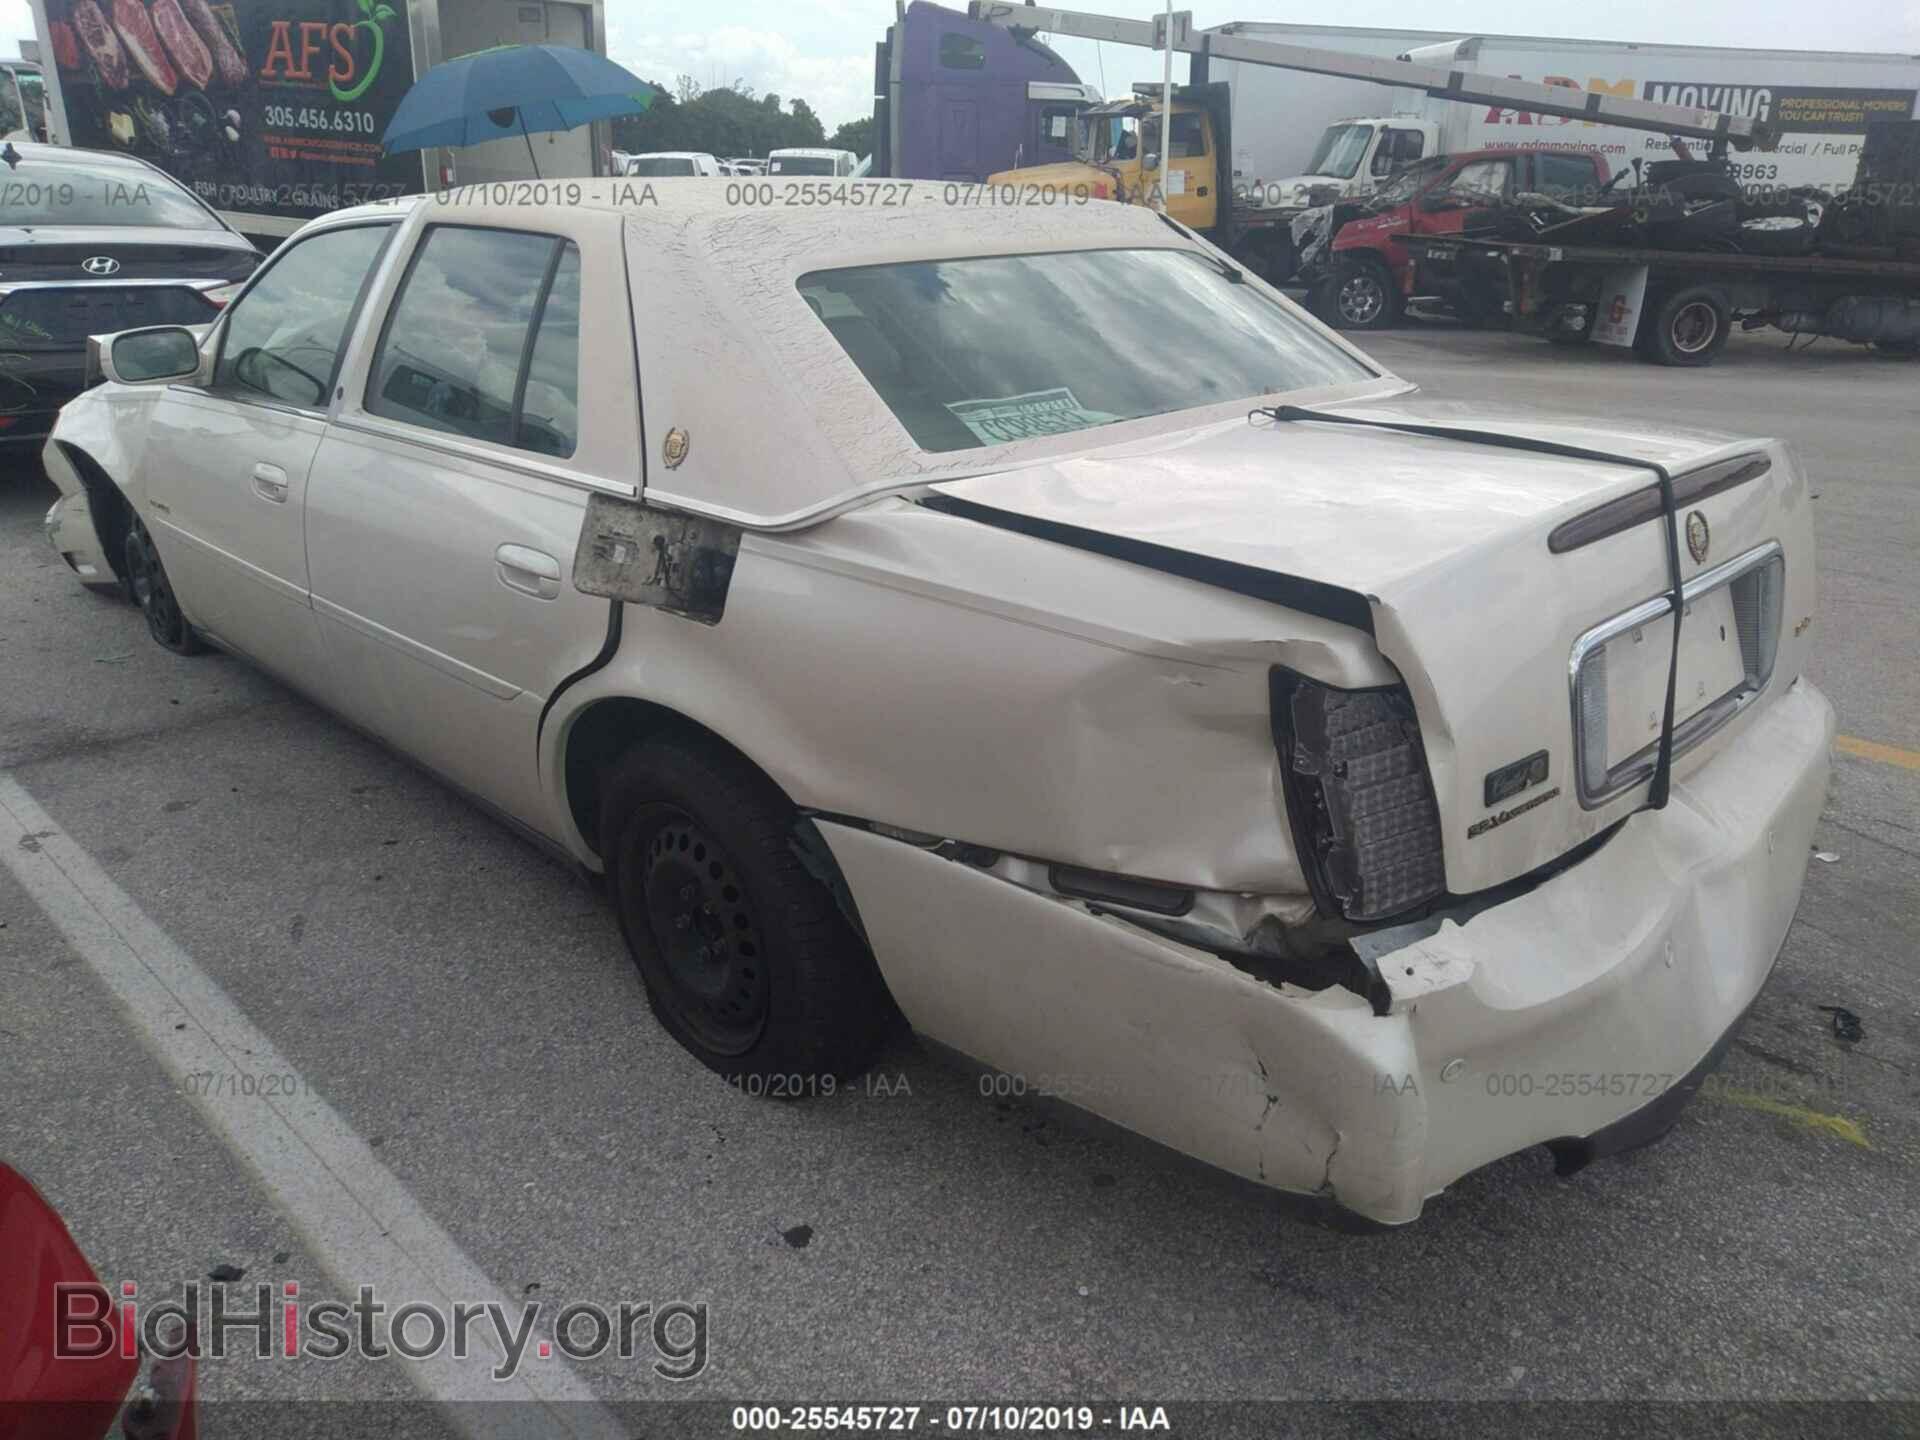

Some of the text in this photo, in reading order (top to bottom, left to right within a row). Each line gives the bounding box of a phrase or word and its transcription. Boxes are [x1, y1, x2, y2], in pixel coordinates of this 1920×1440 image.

[260, 21, 358, 82] AFS
[1652, 84, 1771, 122] MOVING
[1780, 97, 1906, 112] PROFESSIONAL MOVERS
[264, 105, 374, 133] 305.456.6310
[1777, 110, 1801, 121] YOU
[1802, 111, 1826, 121] CAN
[1484, 140, 1626, 155] www.admmoving.com
[1823, 143, 1846, 155] Full
[229, 184, 278, 203] POULTRY
[290, 190, 340, 209] GRAINS
